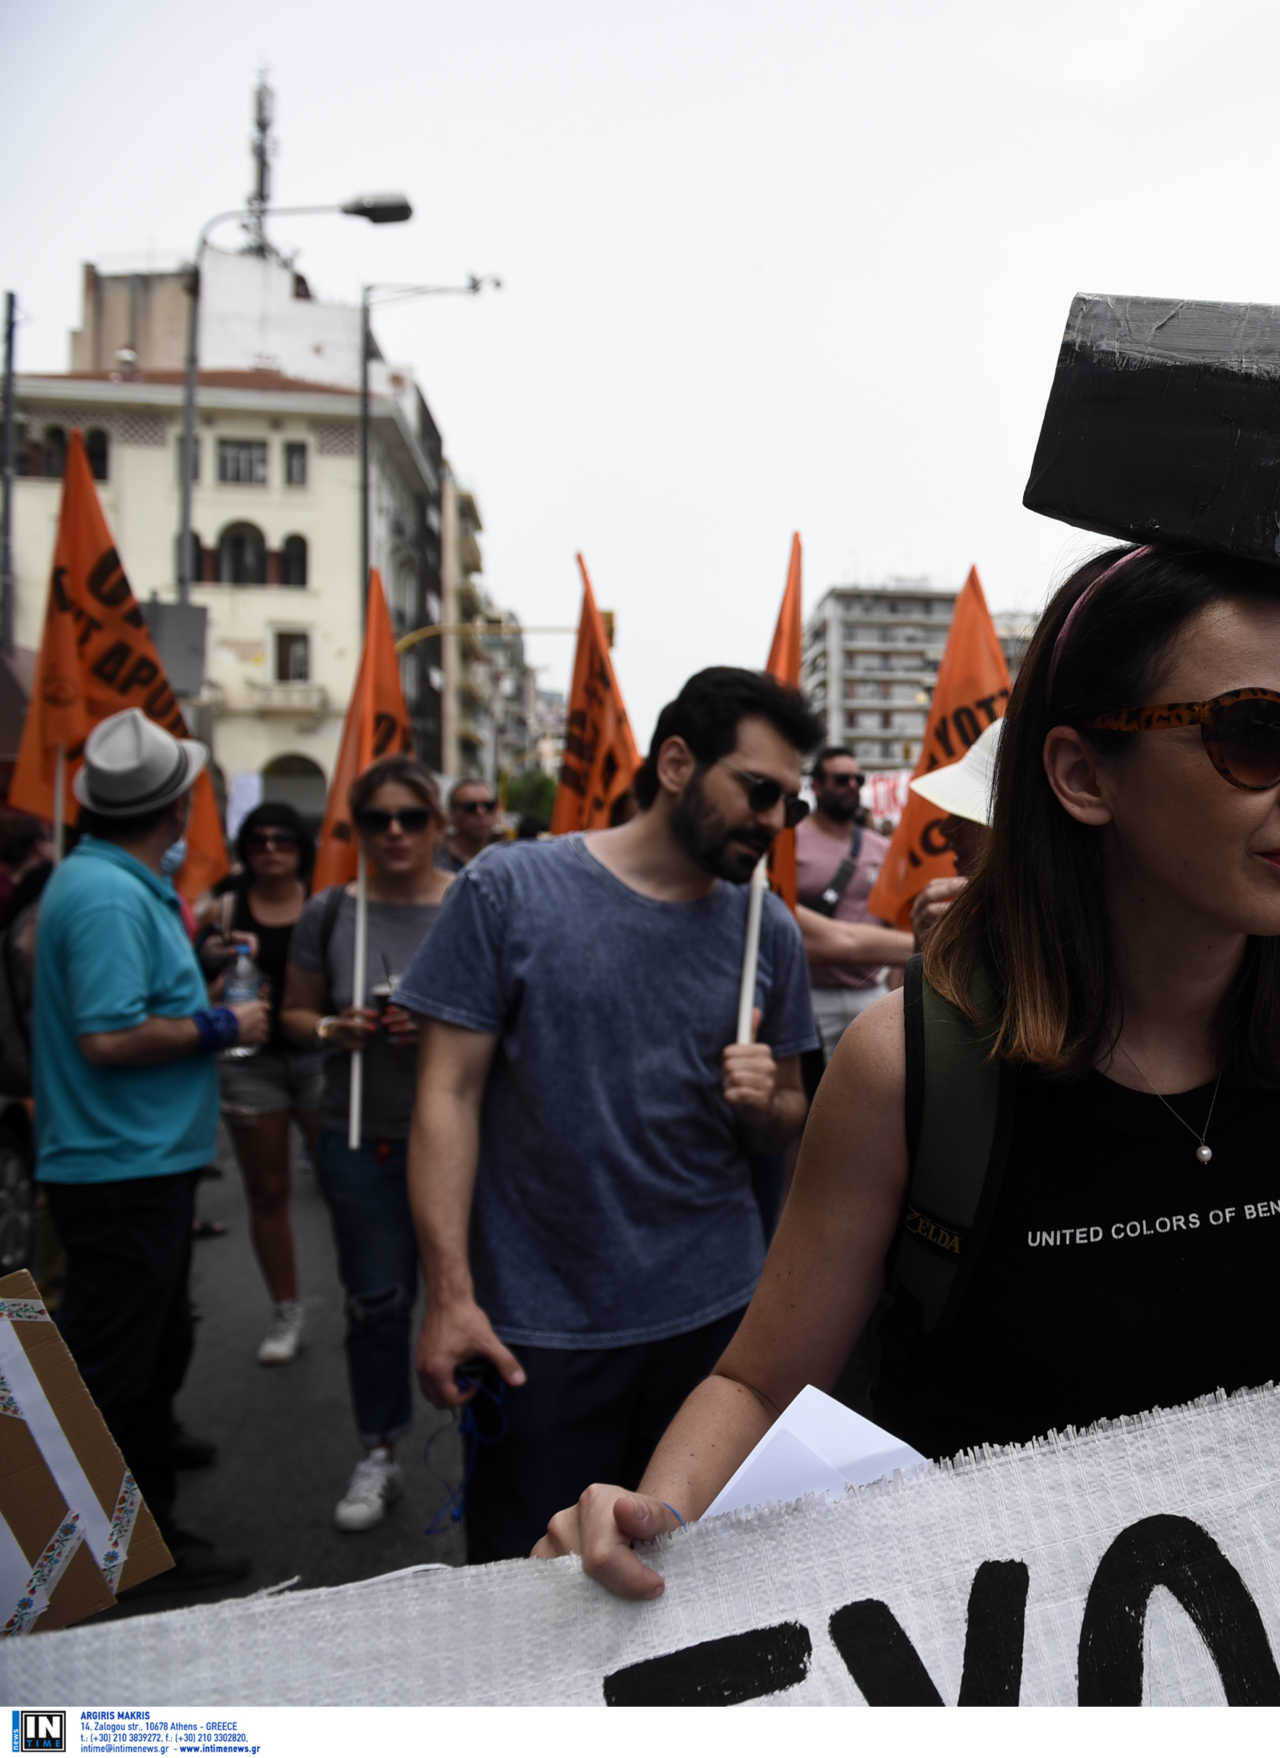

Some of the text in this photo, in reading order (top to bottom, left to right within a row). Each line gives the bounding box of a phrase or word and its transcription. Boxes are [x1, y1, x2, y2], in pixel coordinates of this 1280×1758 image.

[1027, 1226, 1103, 1248] UNITED
[1111, 1212, 1201, 1239] COLORS
[1208, 1207, 1236, 1226] OF
